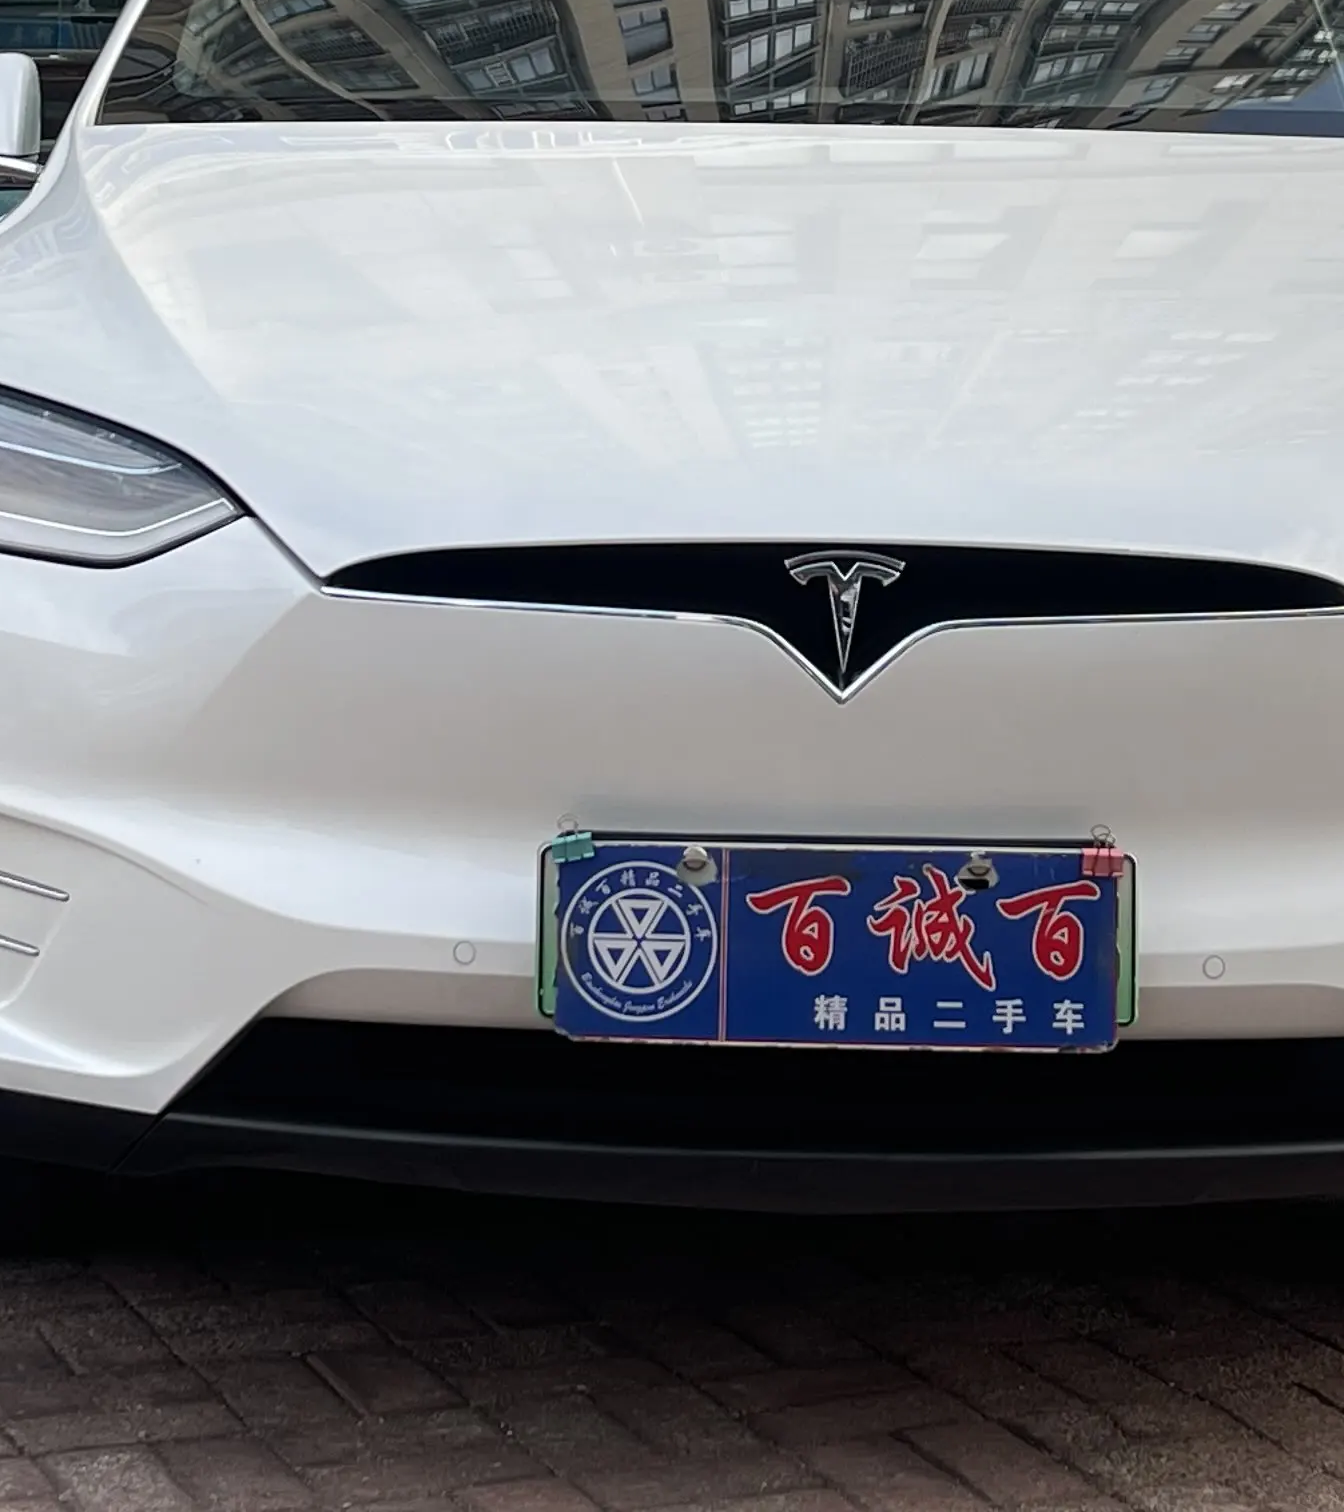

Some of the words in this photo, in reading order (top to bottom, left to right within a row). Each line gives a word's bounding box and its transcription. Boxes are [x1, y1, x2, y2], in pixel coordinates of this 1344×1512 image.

[813, 993, 1085, 1035] 精品二手车
